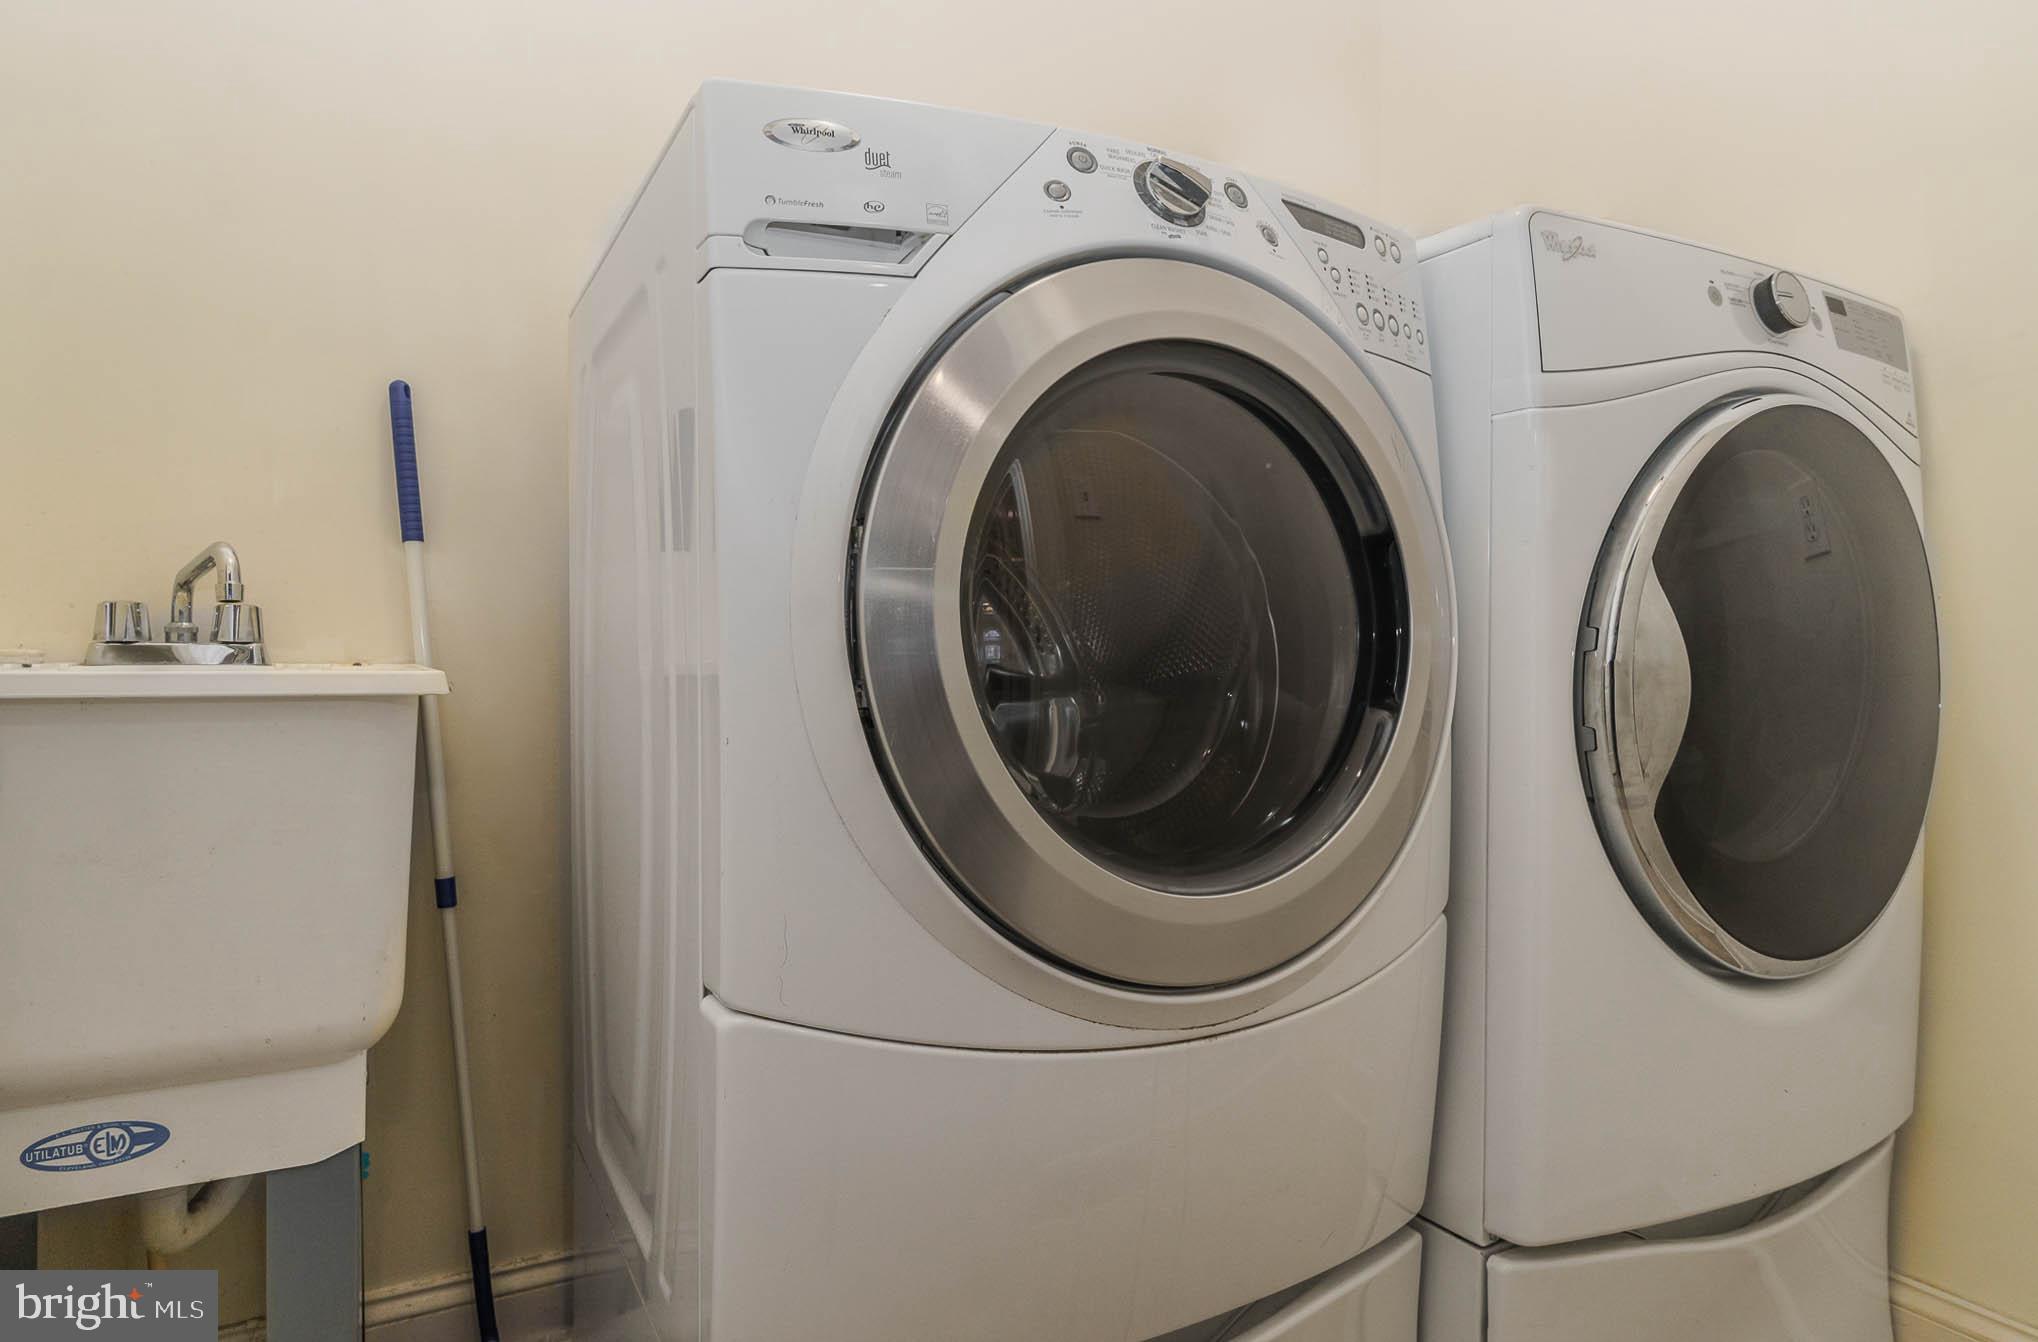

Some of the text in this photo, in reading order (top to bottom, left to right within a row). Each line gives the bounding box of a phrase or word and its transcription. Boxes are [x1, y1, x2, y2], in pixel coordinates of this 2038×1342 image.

[791, 126, 835, 139] Whirlpool
[864, 147, 891, 168] duet
[778, 197, 825, 209] TumbleFresh
[865, 201, 884, 212] he
[93, 1131, 127, 1157] ELM
[25, 1143, 84, 1162] UTILATUB
